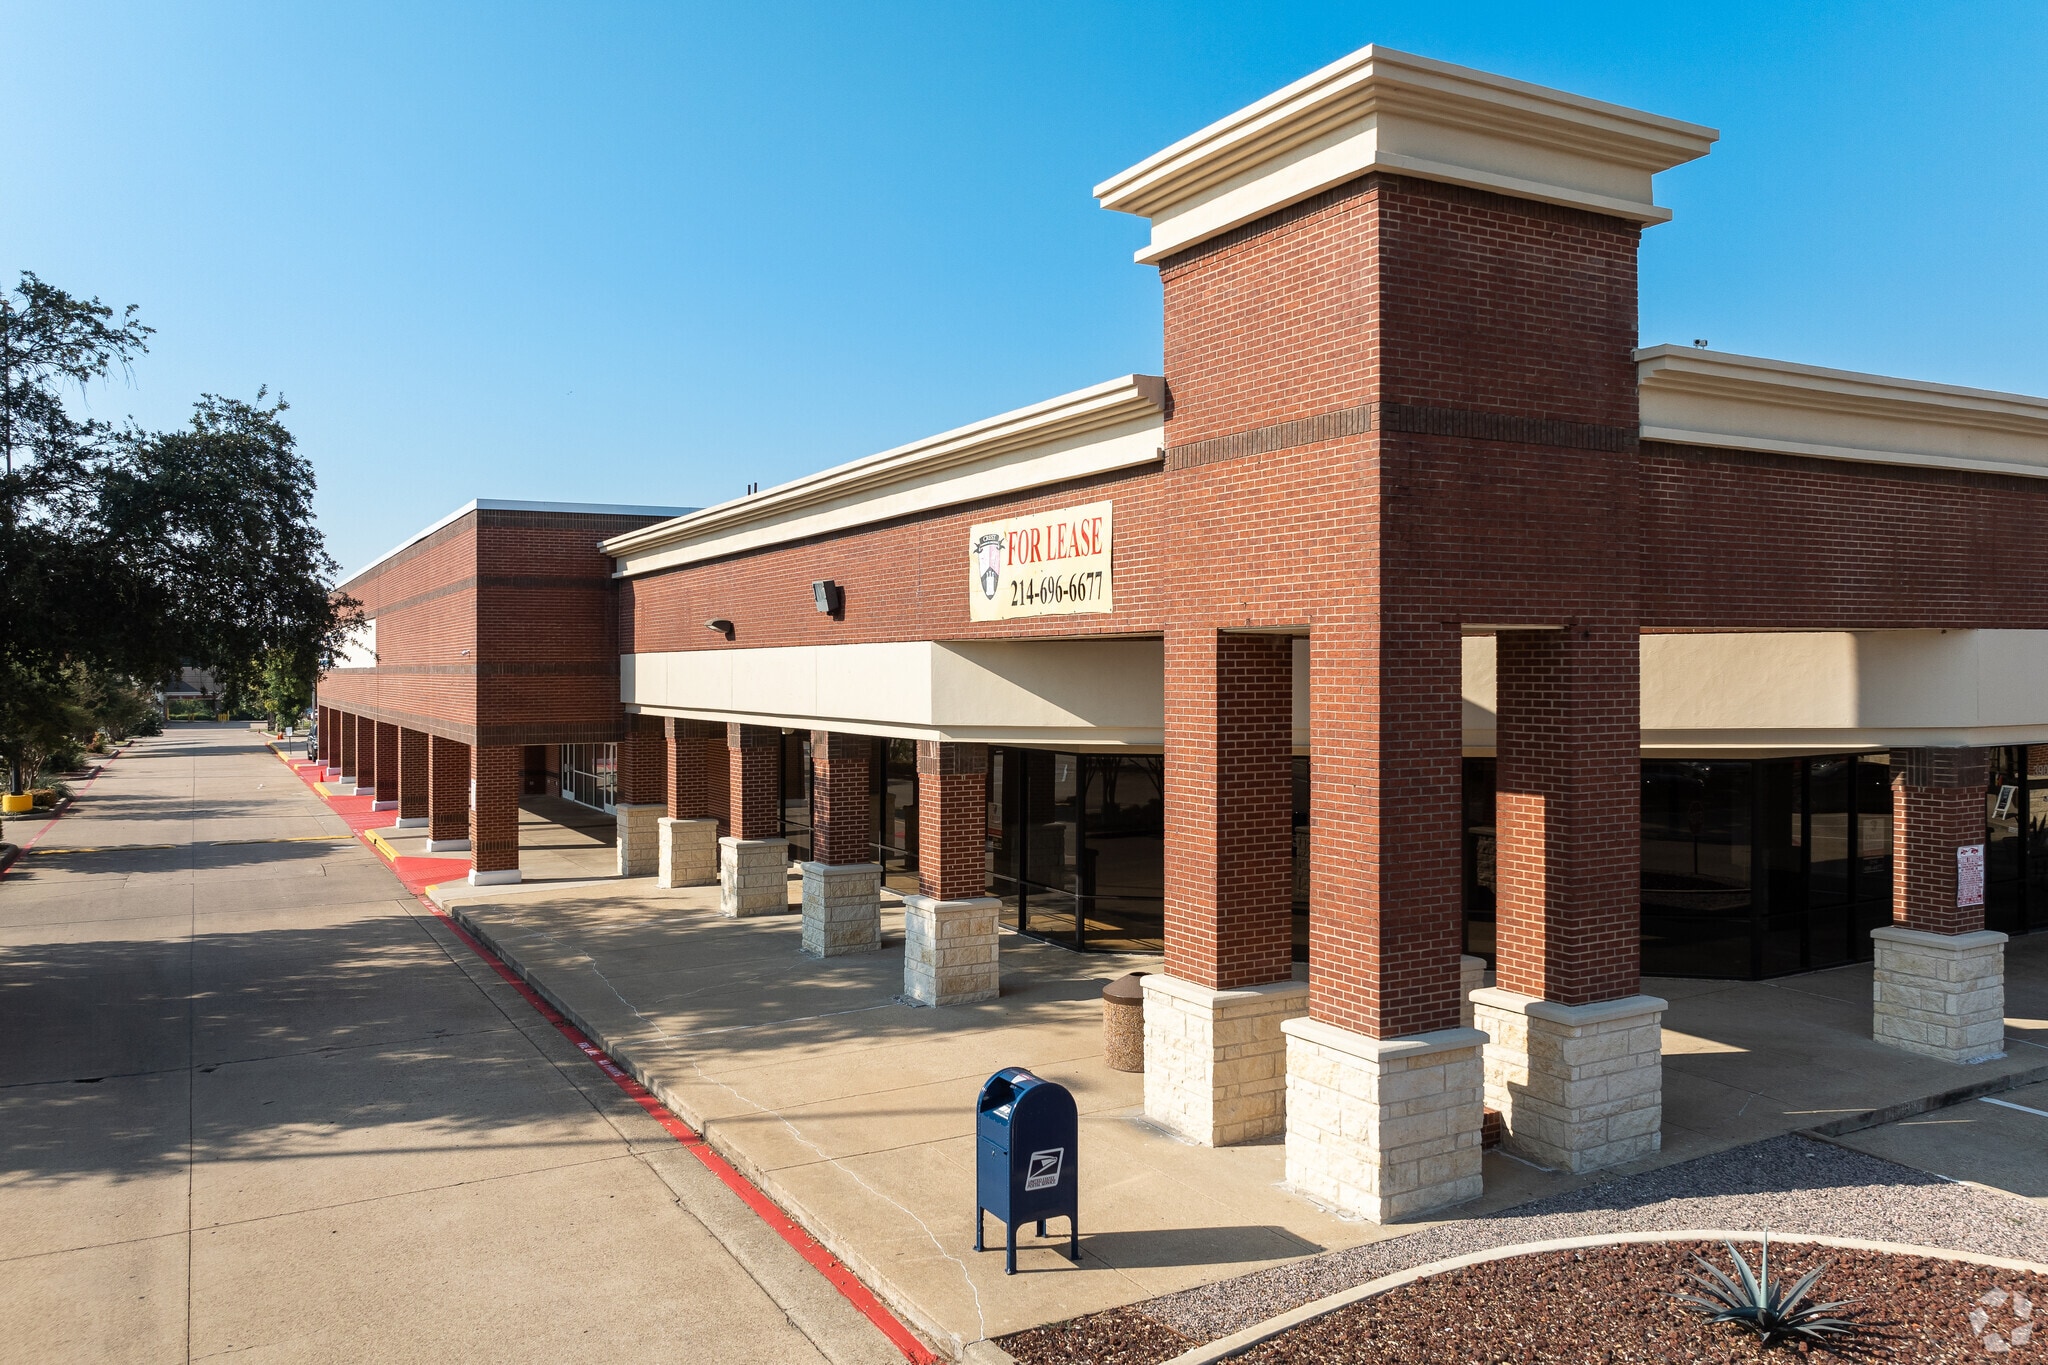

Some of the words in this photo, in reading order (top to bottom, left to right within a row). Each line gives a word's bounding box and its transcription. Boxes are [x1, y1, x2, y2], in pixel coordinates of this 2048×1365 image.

[1007, 527, 1042, 566] FOR
[1046, 517, 1103, 561] LEASE
[1011, 571, 1103, 606] 214-696-6677
